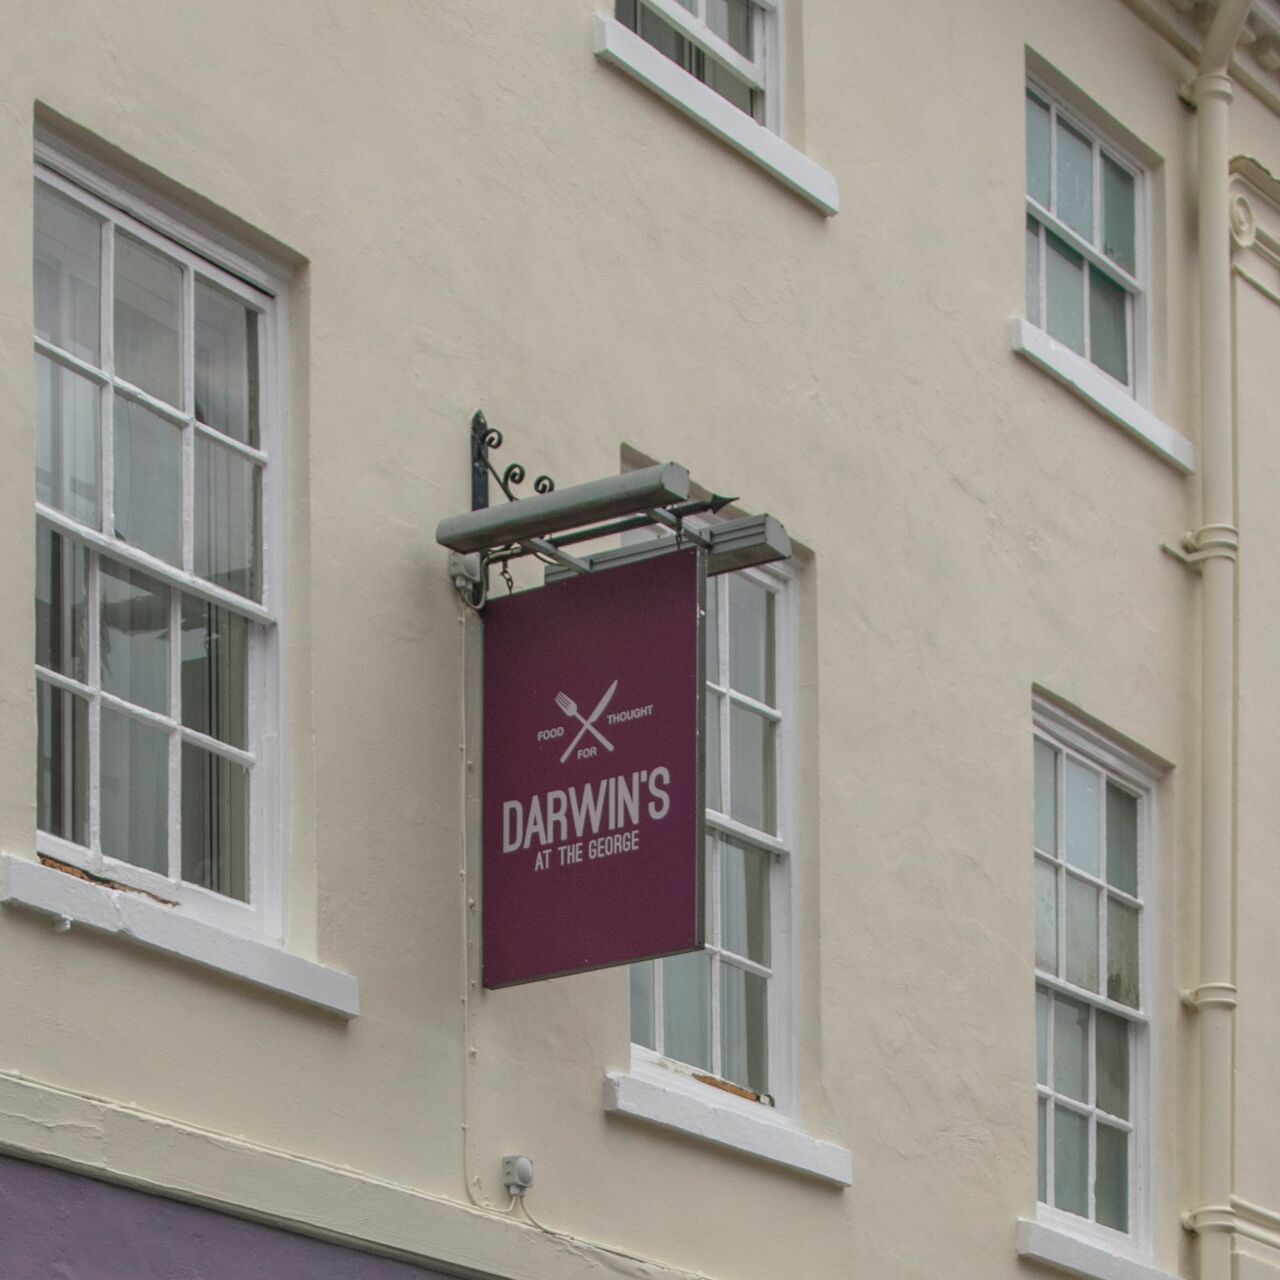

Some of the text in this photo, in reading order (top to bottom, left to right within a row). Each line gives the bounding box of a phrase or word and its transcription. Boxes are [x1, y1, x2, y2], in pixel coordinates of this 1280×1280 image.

[538, 705, 654, 741] FOOD THOUGHT
[577, 747, 597, 759] FOR
[502, 766, 670, 853] DARWIN'S
[535, 830, 639, 871] AT THE GEORGE
